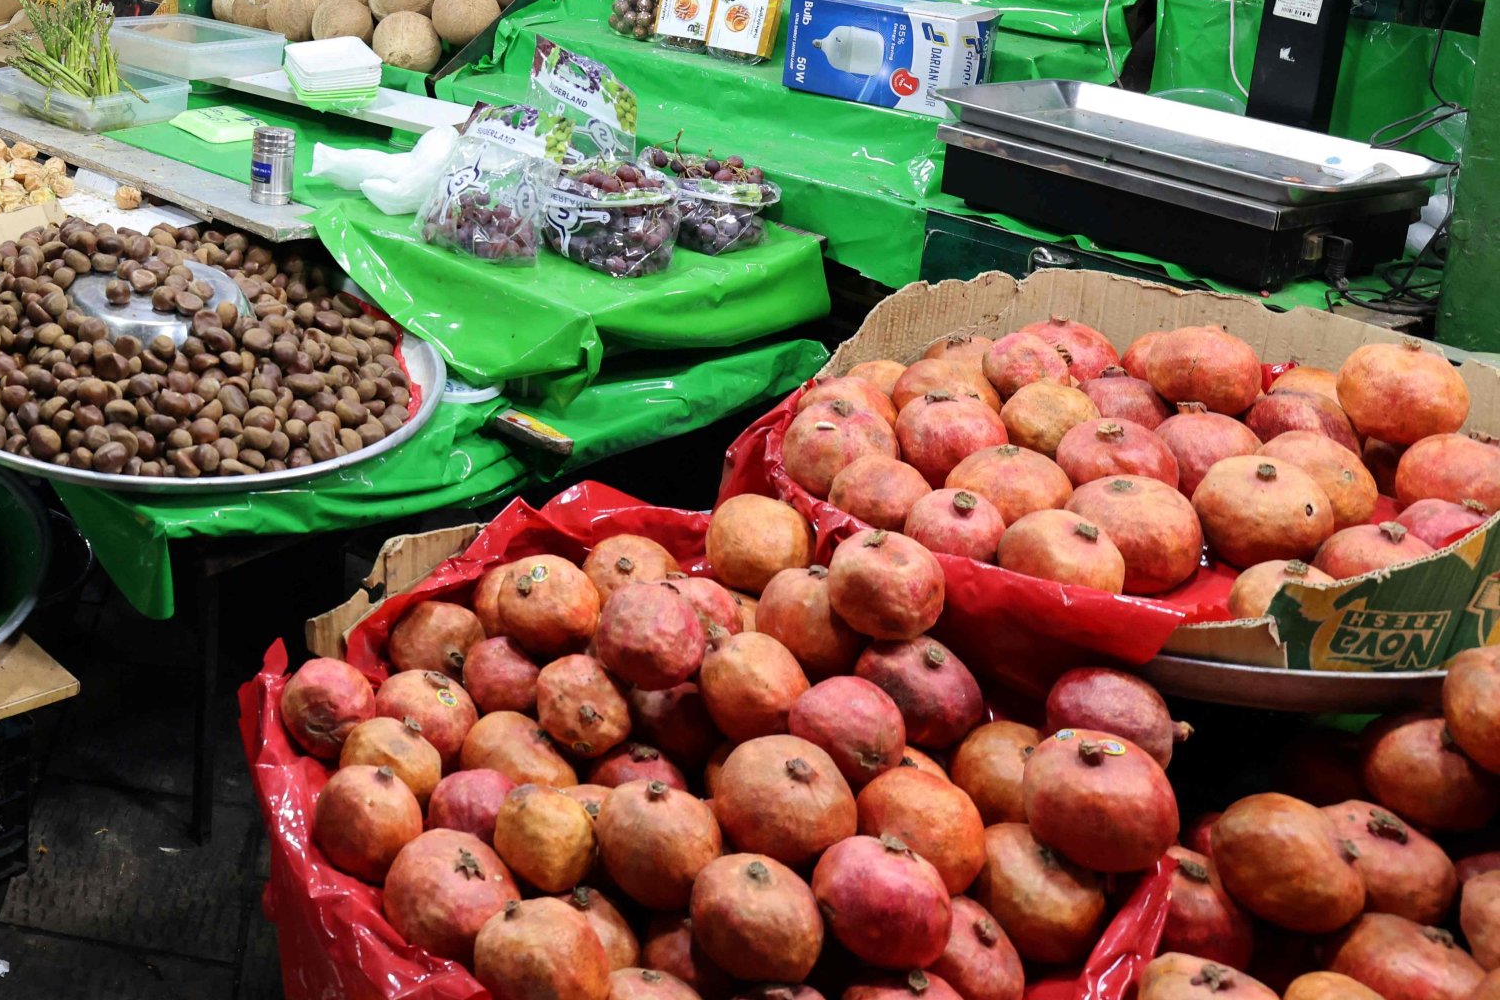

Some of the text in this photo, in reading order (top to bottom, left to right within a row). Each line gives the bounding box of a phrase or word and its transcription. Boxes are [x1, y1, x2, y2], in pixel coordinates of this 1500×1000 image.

[802, 0, 813, 26] Bulb
[899, 23, 907, 45] 85%
[925, 47, 942, 107] DARIAN NOR
[1349, 611, 1449, 629] FRESH
